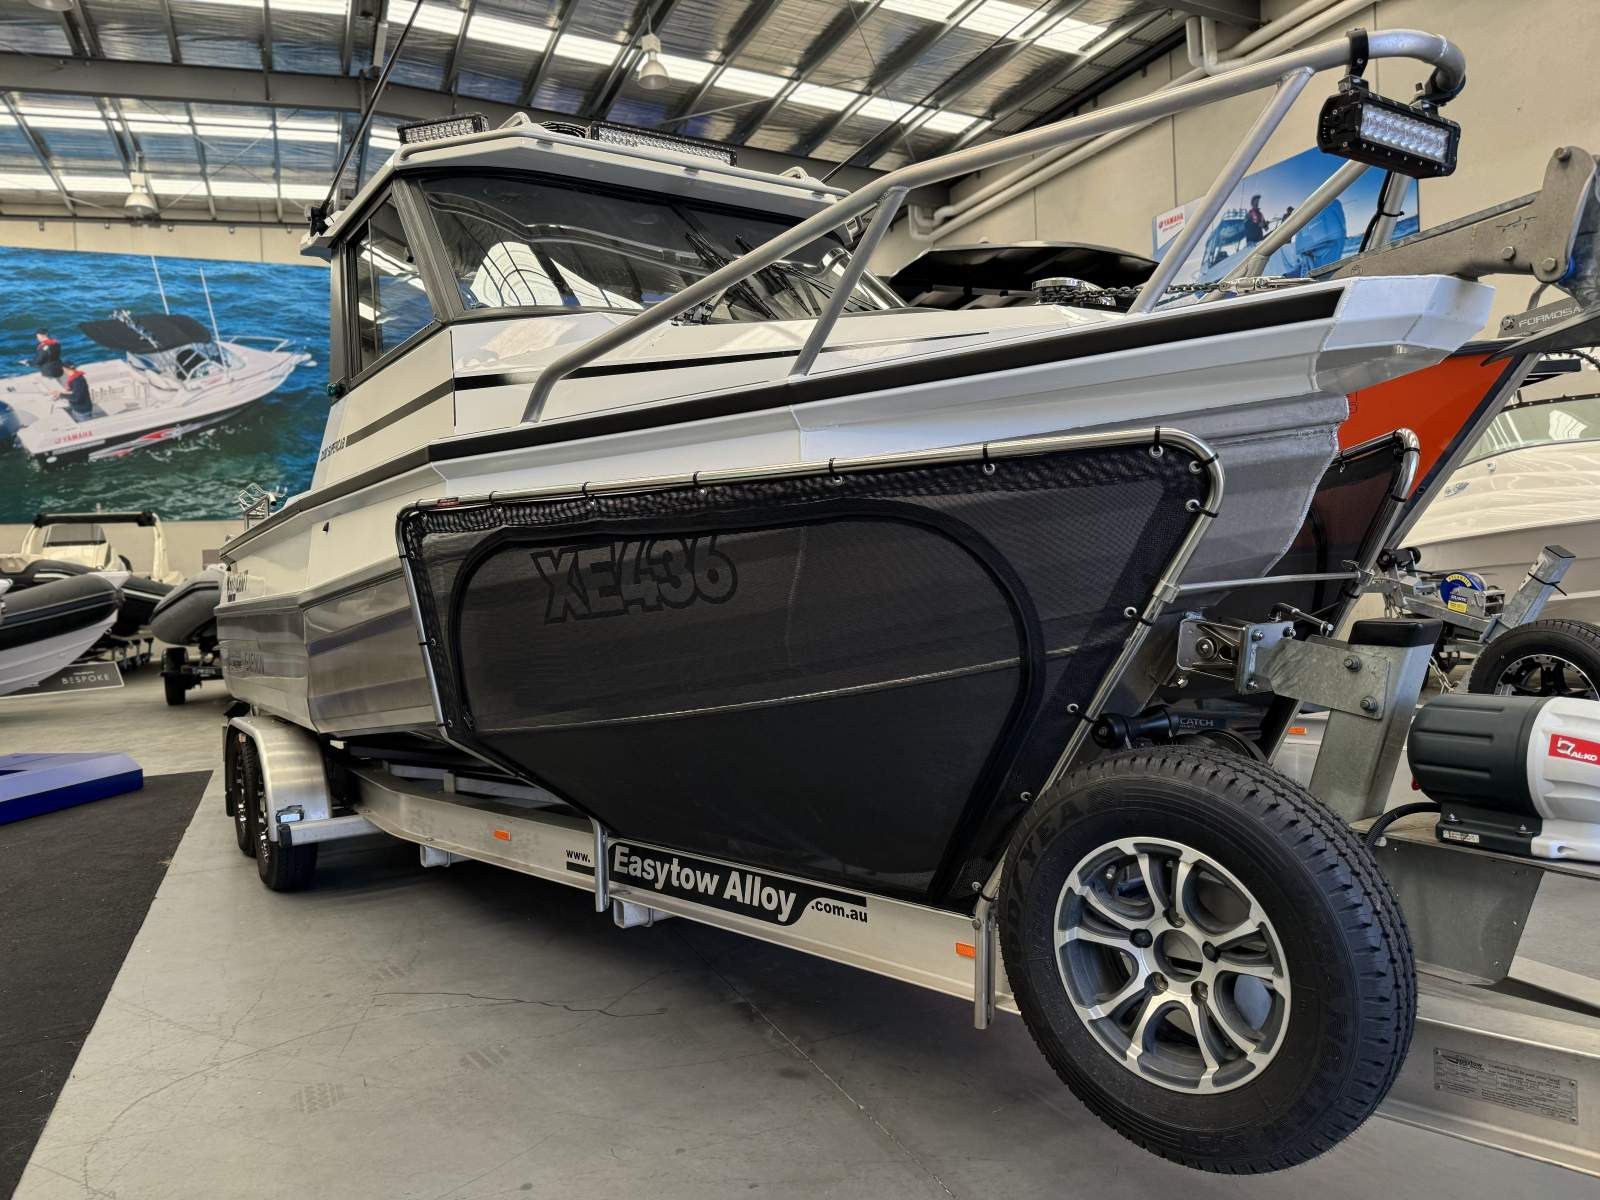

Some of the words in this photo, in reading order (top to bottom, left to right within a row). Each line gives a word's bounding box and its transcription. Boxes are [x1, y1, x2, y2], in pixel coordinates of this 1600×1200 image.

[1518, 306, 1581, 327] FORMOSA
[63, 431, 93, 441] YAMAHA
[530, 537, 738, 625] XE436
[61, 673, 110, 685] BESPOKE
[565, 849, 591, 863] www.
[613, 845, 719, 896] Easytow
[722, 870, 797, 922] Alloy
[810, 899, 868, 923] .com.au
